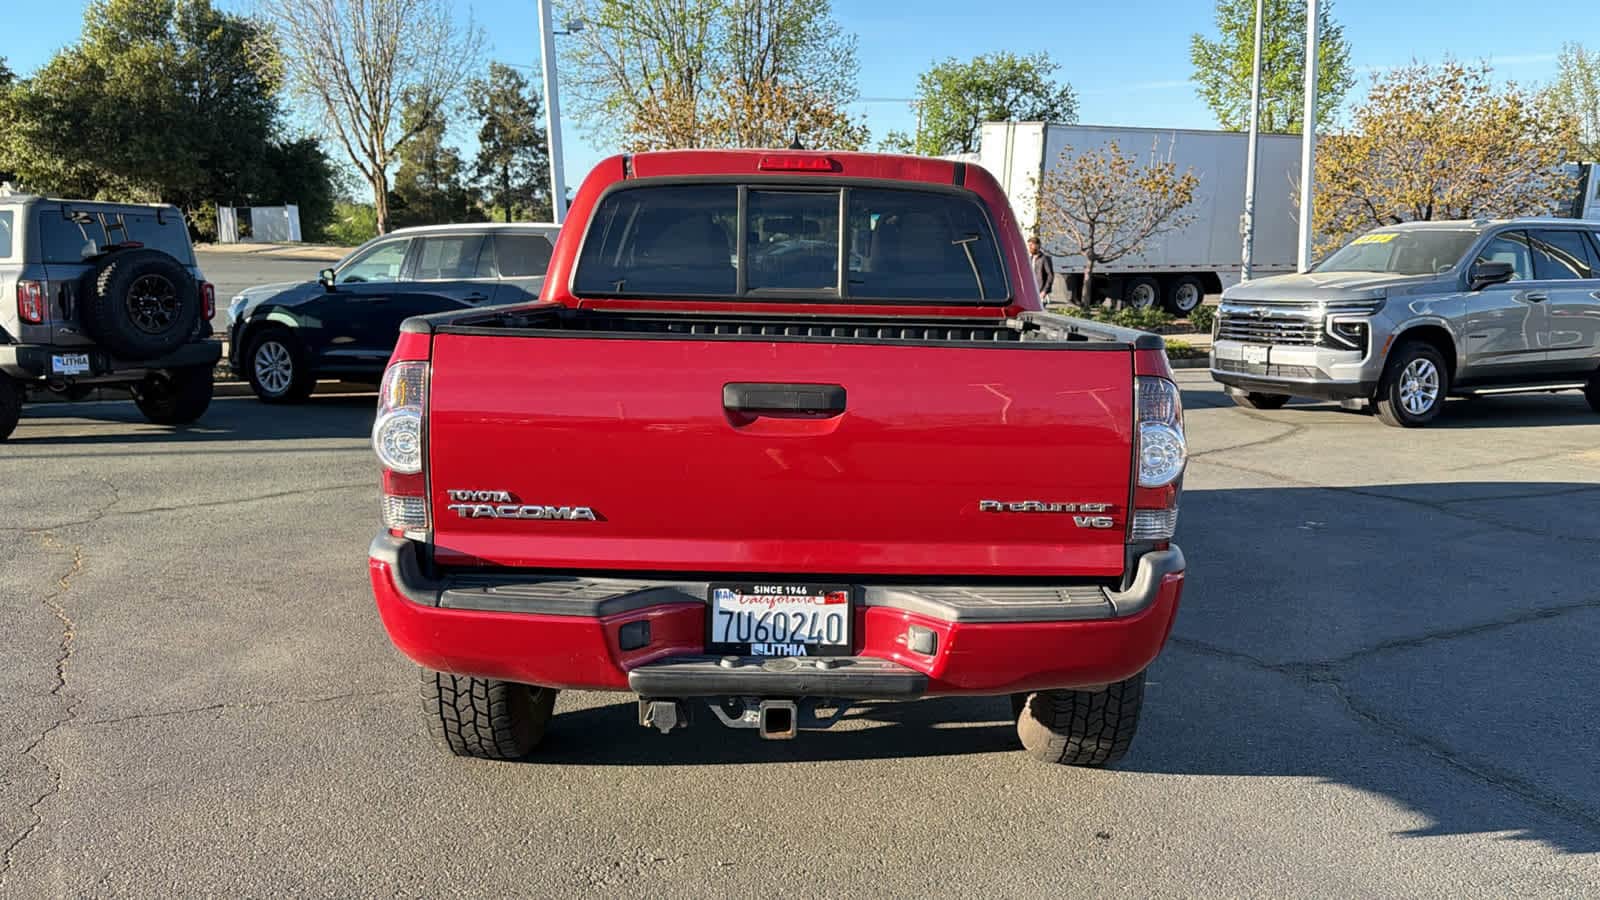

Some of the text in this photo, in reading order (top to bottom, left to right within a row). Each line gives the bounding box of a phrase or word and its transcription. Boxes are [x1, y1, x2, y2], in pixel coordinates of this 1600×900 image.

[447, 489, 512, 502] TOYOTA
[447, 504, 596, 520] TACOMA
[979, 500, 1113, 512] PreRunner
[1073, 516, 1114, 528] V6
[753, 585, 807, 595] SINCE 1946
[719, 610, 842, 643] 7U60240
[763, 643, 808, 656] LITHIA
